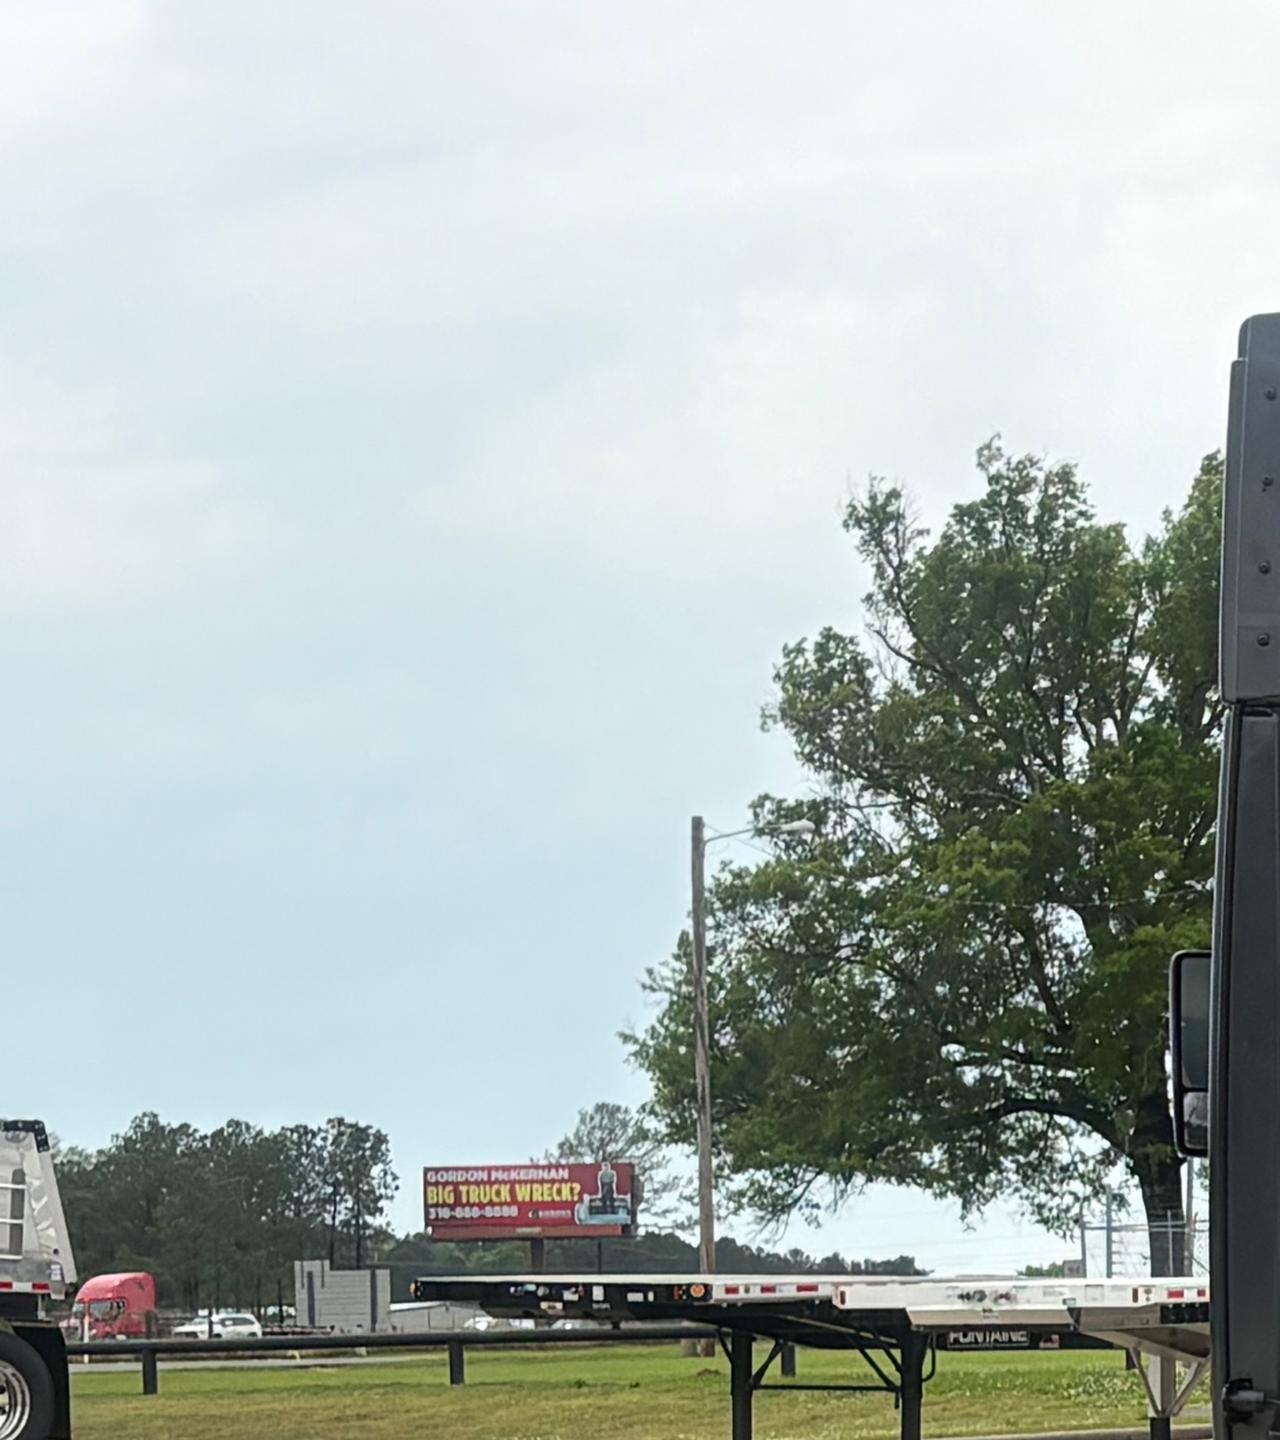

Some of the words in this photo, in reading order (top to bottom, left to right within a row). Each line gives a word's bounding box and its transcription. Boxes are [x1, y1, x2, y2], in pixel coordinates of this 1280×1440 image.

[426, 1171, 488, 1183] GORDON
[490, 1168, 570, 1182] McKERNAN
[426, 1184, 455, 1205] BIG
[459, 1183, 512, 1204] TRUCK
[515, 1182, 582, 1202] WRECK?
[949, 1331, 1027, 1343] FONTAINE
